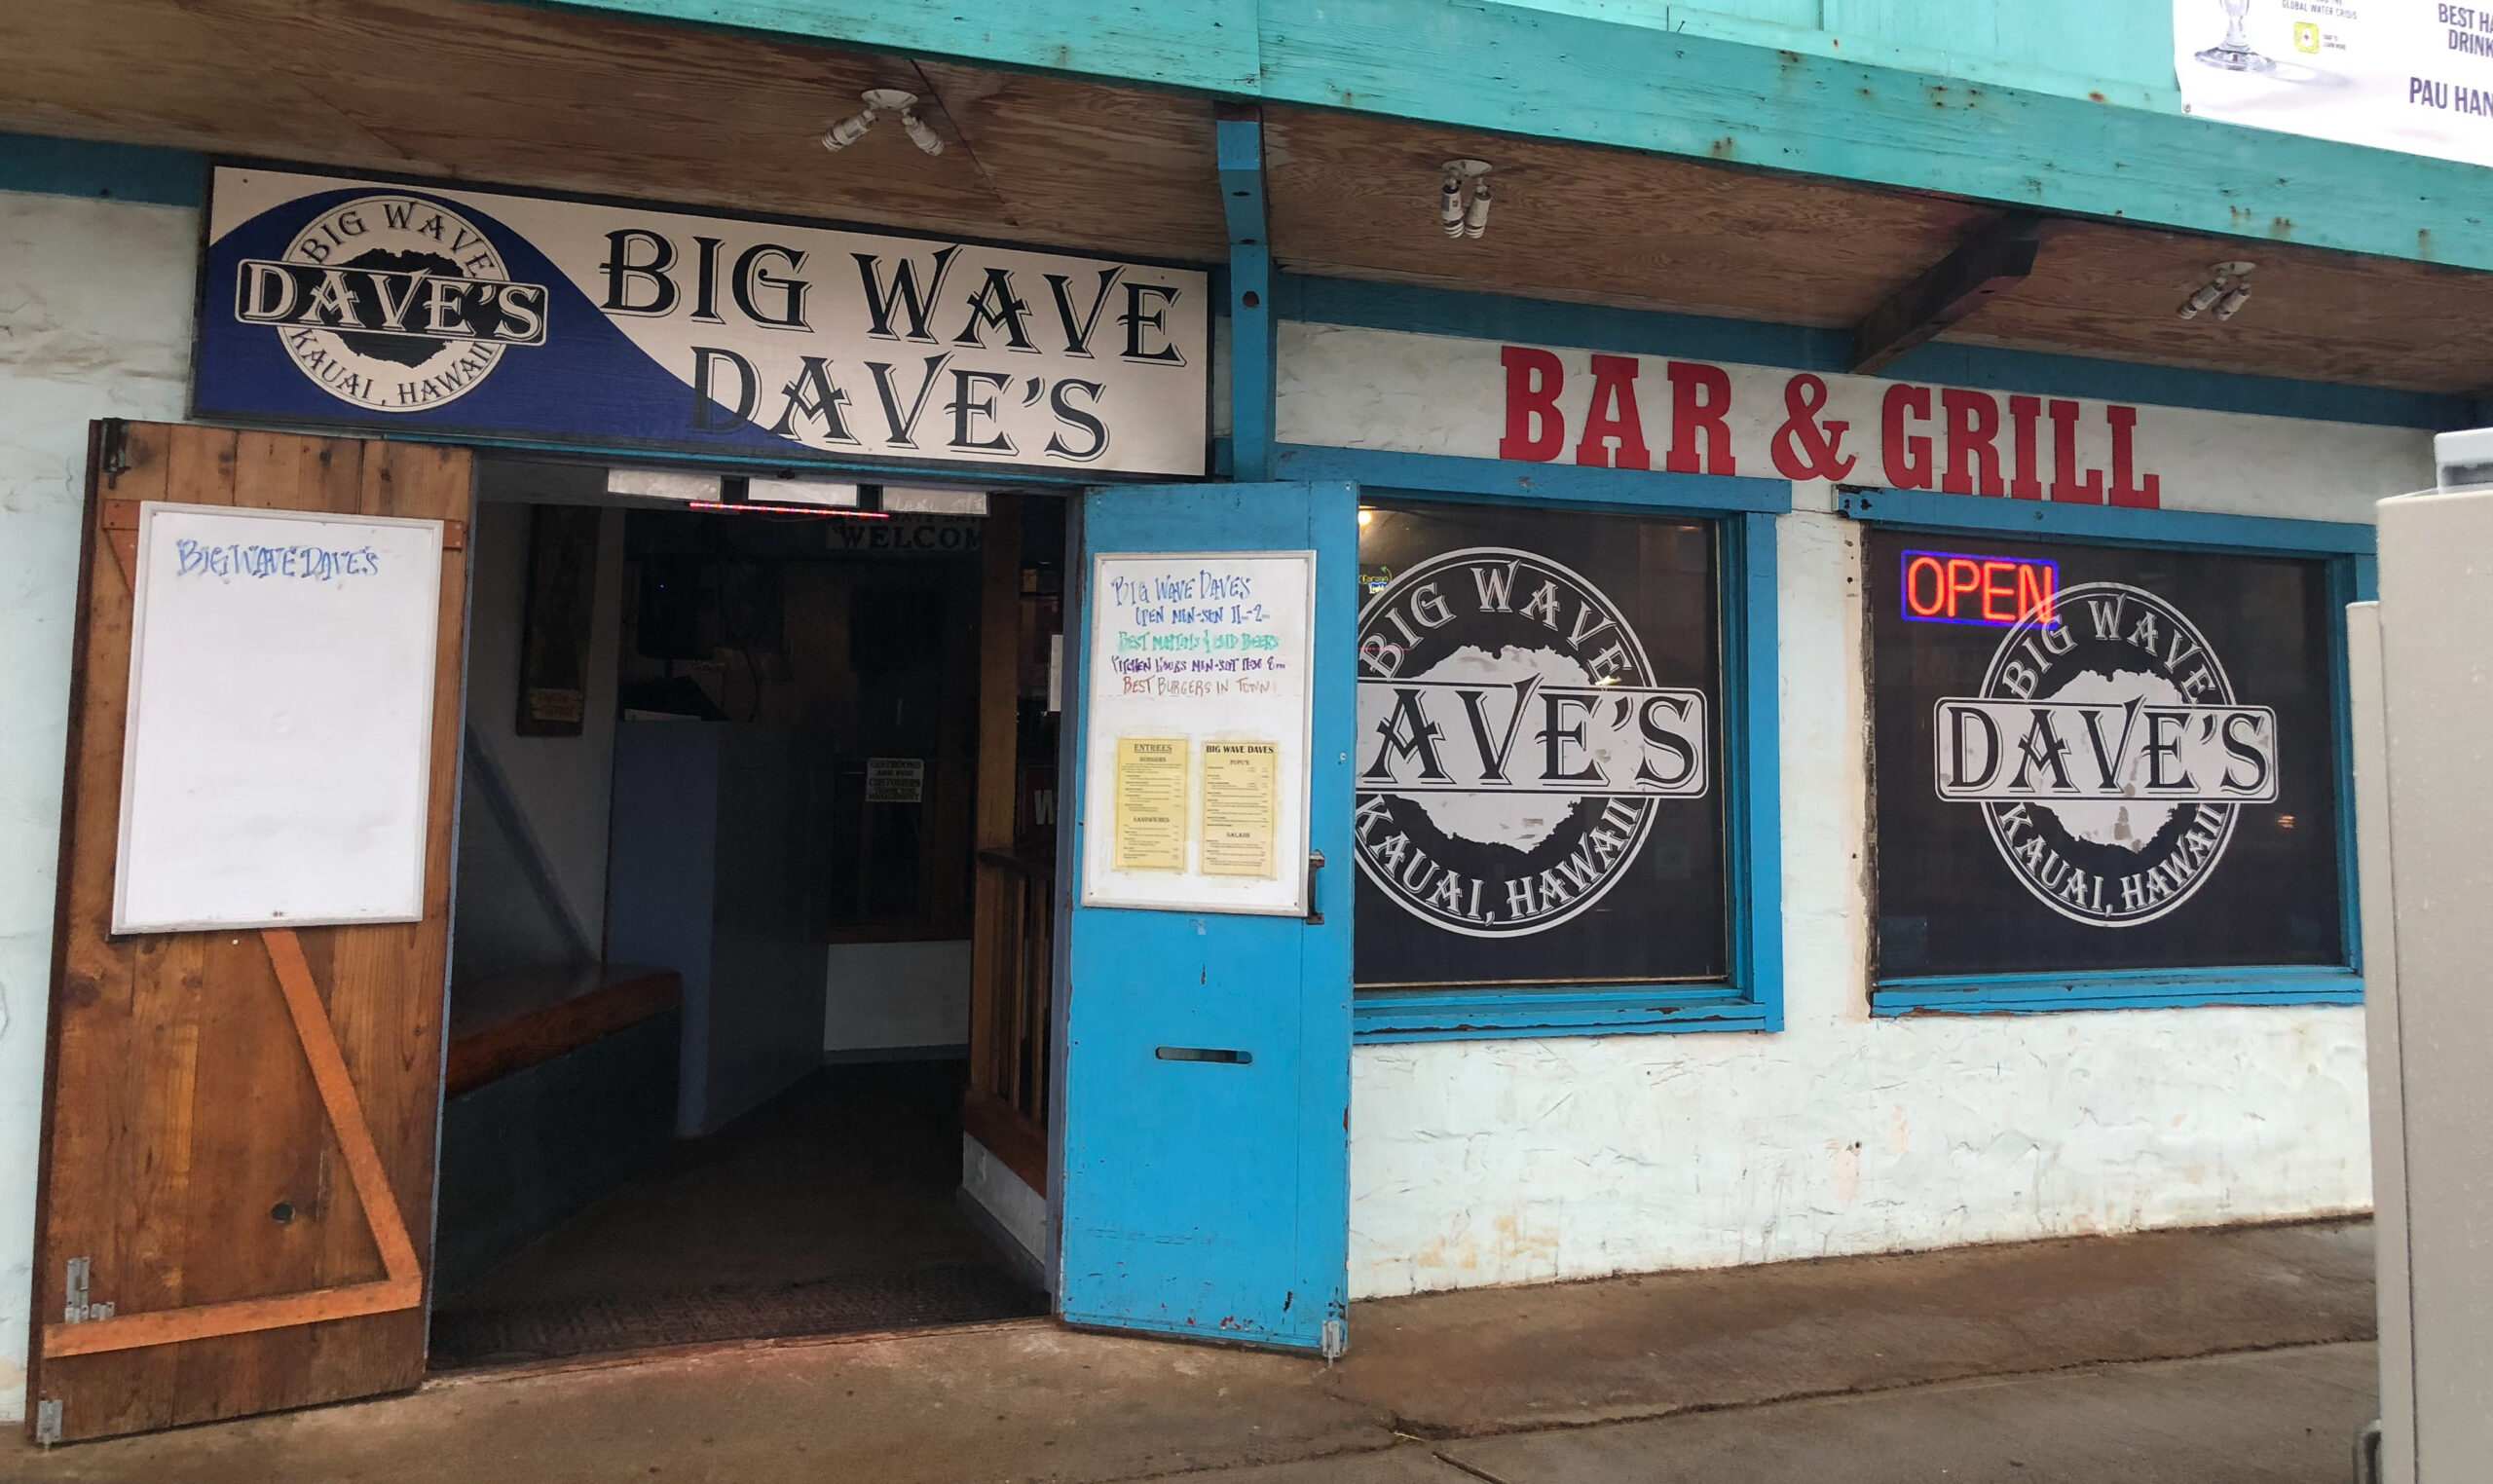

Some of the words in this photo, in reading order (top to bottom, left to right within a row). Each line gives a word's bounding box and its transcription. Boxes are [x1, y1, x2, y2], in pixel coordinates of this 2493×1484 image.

[2311, 4, 2333, 16] WATER
[2438, 3, 2474, 29] BEST
[2448, 29, 2493, 58] DRINK
[2409, 77, 2448, 109] PAU
[302, 207, 369, 263] BIG
[384, 202, 500, 278] WAVE
[243, 261, 543, 343] DAVE'S
[599, 228, 814, 333] BIG
[850, 243, 1188, 368] WAVE
[397, 342, 500, 404] HAWAII
[685, 346, 1110, 461] DAVE'S
[1499, 345, 1735, 475] BAR
[1770, 373, 1857, 481] &
[1881, 384, 2160, 509] GRILL
[230, 543, 297, 578] WAVE
[1111, 575, 1151, 606] BIG
[1155, 575, 1196, 603] WAVE
[1908, 555, 2055, 625] OPEN
[1119, 631, 1151, 652] BEST
[1241, 633, 1280, 651] BEERS
[1135, 606, 1165, 626] OPEN
[1359, 582, 1457, 680] BIG
[1470, 559, 1633, 684] WAVE
[1111, 655, 1151, 675] KITCHEN
[2003, 613, 2077, 701] BIG
[2087, 593, 2217, 704] WAVE
[1123, 676, 1156, 695] BEST
[1157, 677, 1211, 695] BURGERS
[1216, 680, 1229, 694] IN
[1134, 743, 1172, 753] ENTREES
[1206, 745, 1221, 754] BIG
[1223, 745, 1245, 754] WAVE
[1247, 746, 1274, 755] DAVES
[1361, 673, 1700, 791] AVE'S
[1945, 694, 2271, 797] DAVE'S
[1505, 797, 1643, 919] HAWAII
[2123, 803, 2227, 911] HAWAII
